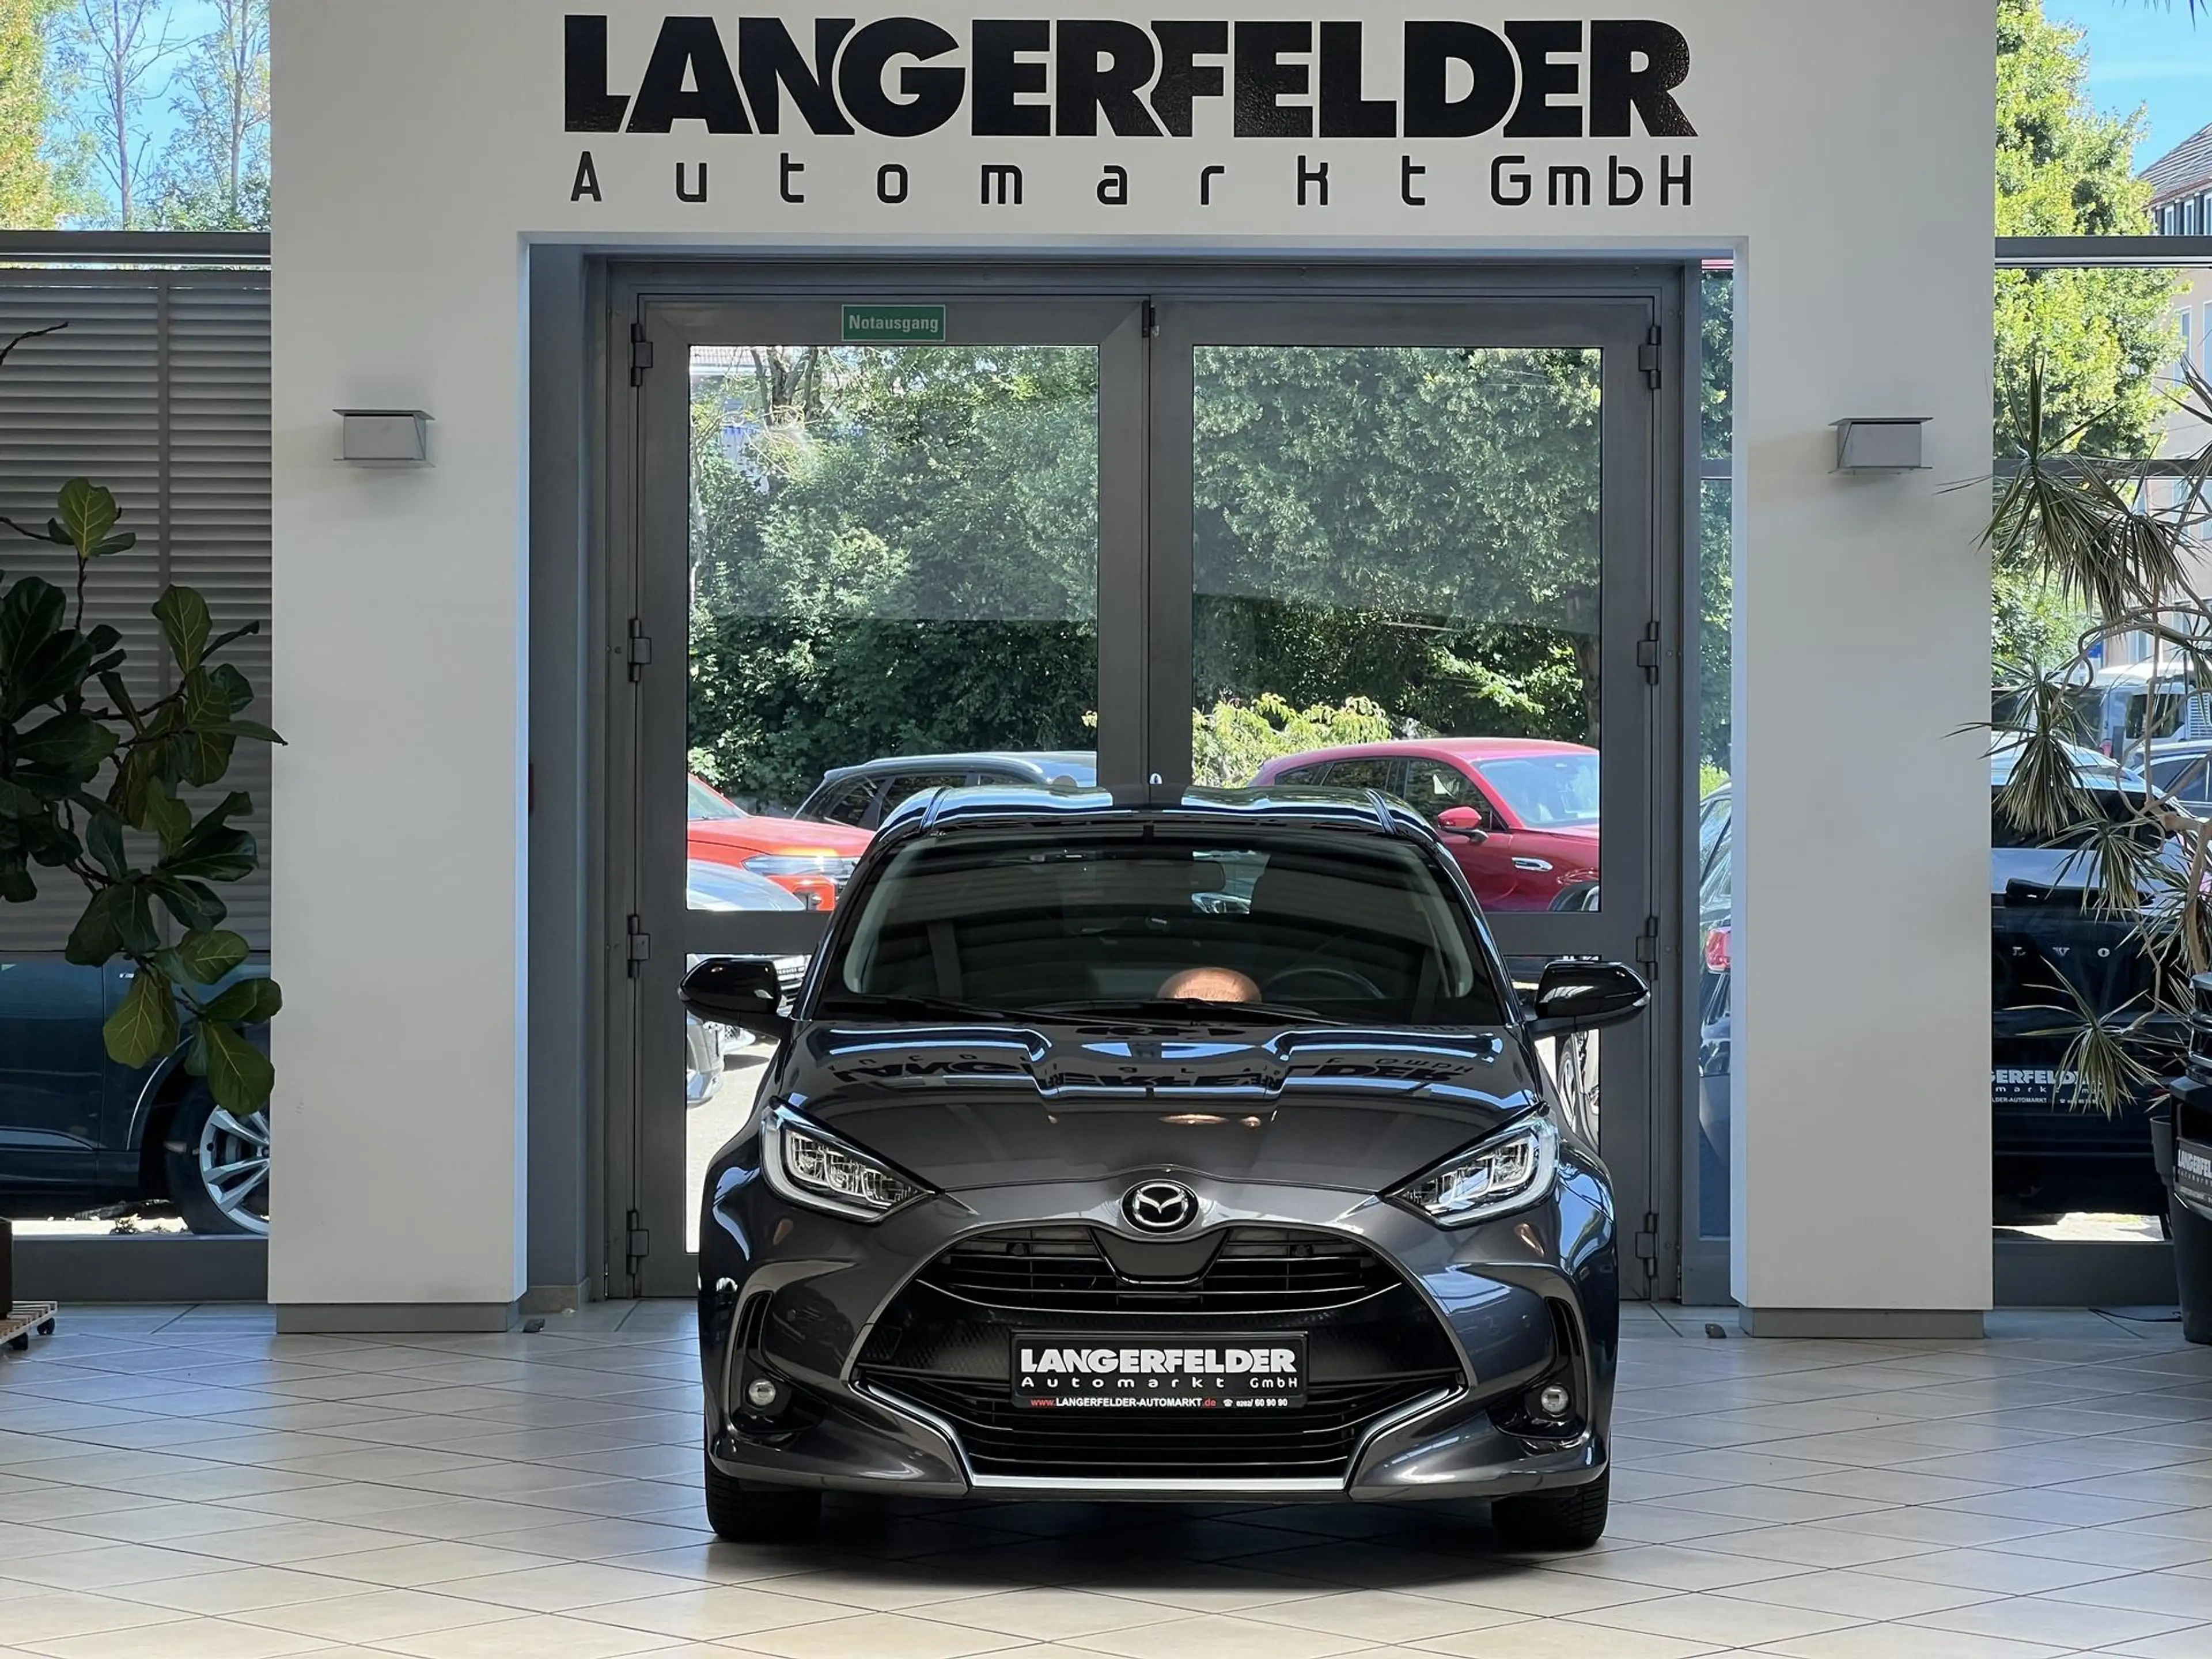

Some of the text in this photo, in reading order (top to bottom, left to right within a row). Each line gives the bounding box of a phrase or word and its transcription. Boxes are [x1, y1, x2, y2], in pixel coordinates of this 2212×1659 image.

[565, 15, 1698, 138] LANGERFELDER
[570, 151, 1692, 206] Automarkt GmbH
[849, 315, 938, 332] Notausgang
[1021, 1349, 1297, 1373] LANGERFELDER
[1021, 1376, 1297, 1388] Automarkt GmbH
